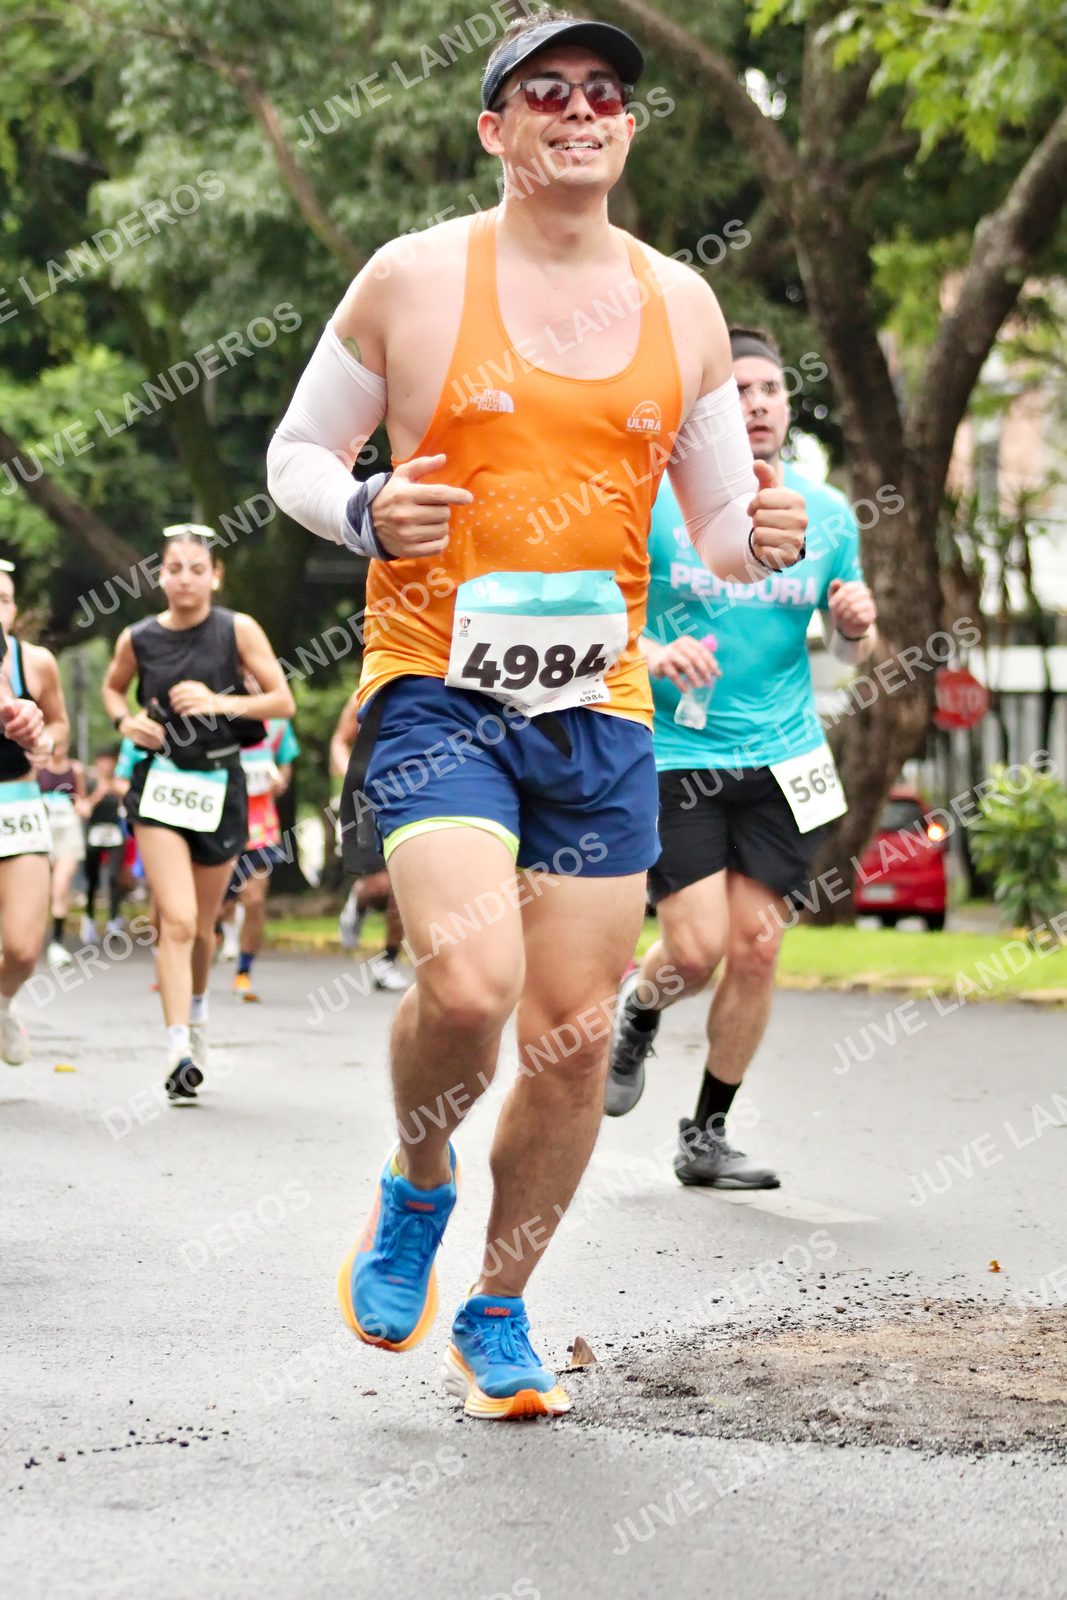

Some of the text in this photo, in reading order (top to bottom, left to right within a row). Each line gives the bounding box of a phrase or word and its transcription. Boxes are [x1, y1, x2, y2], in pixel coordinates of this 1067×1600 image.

[626, 416, 661, 431] ULTRA
[461, 642, 607, 691] 4984
[579, 693, 605, 703] 4984
[152, 784, 215, 814] 6566
